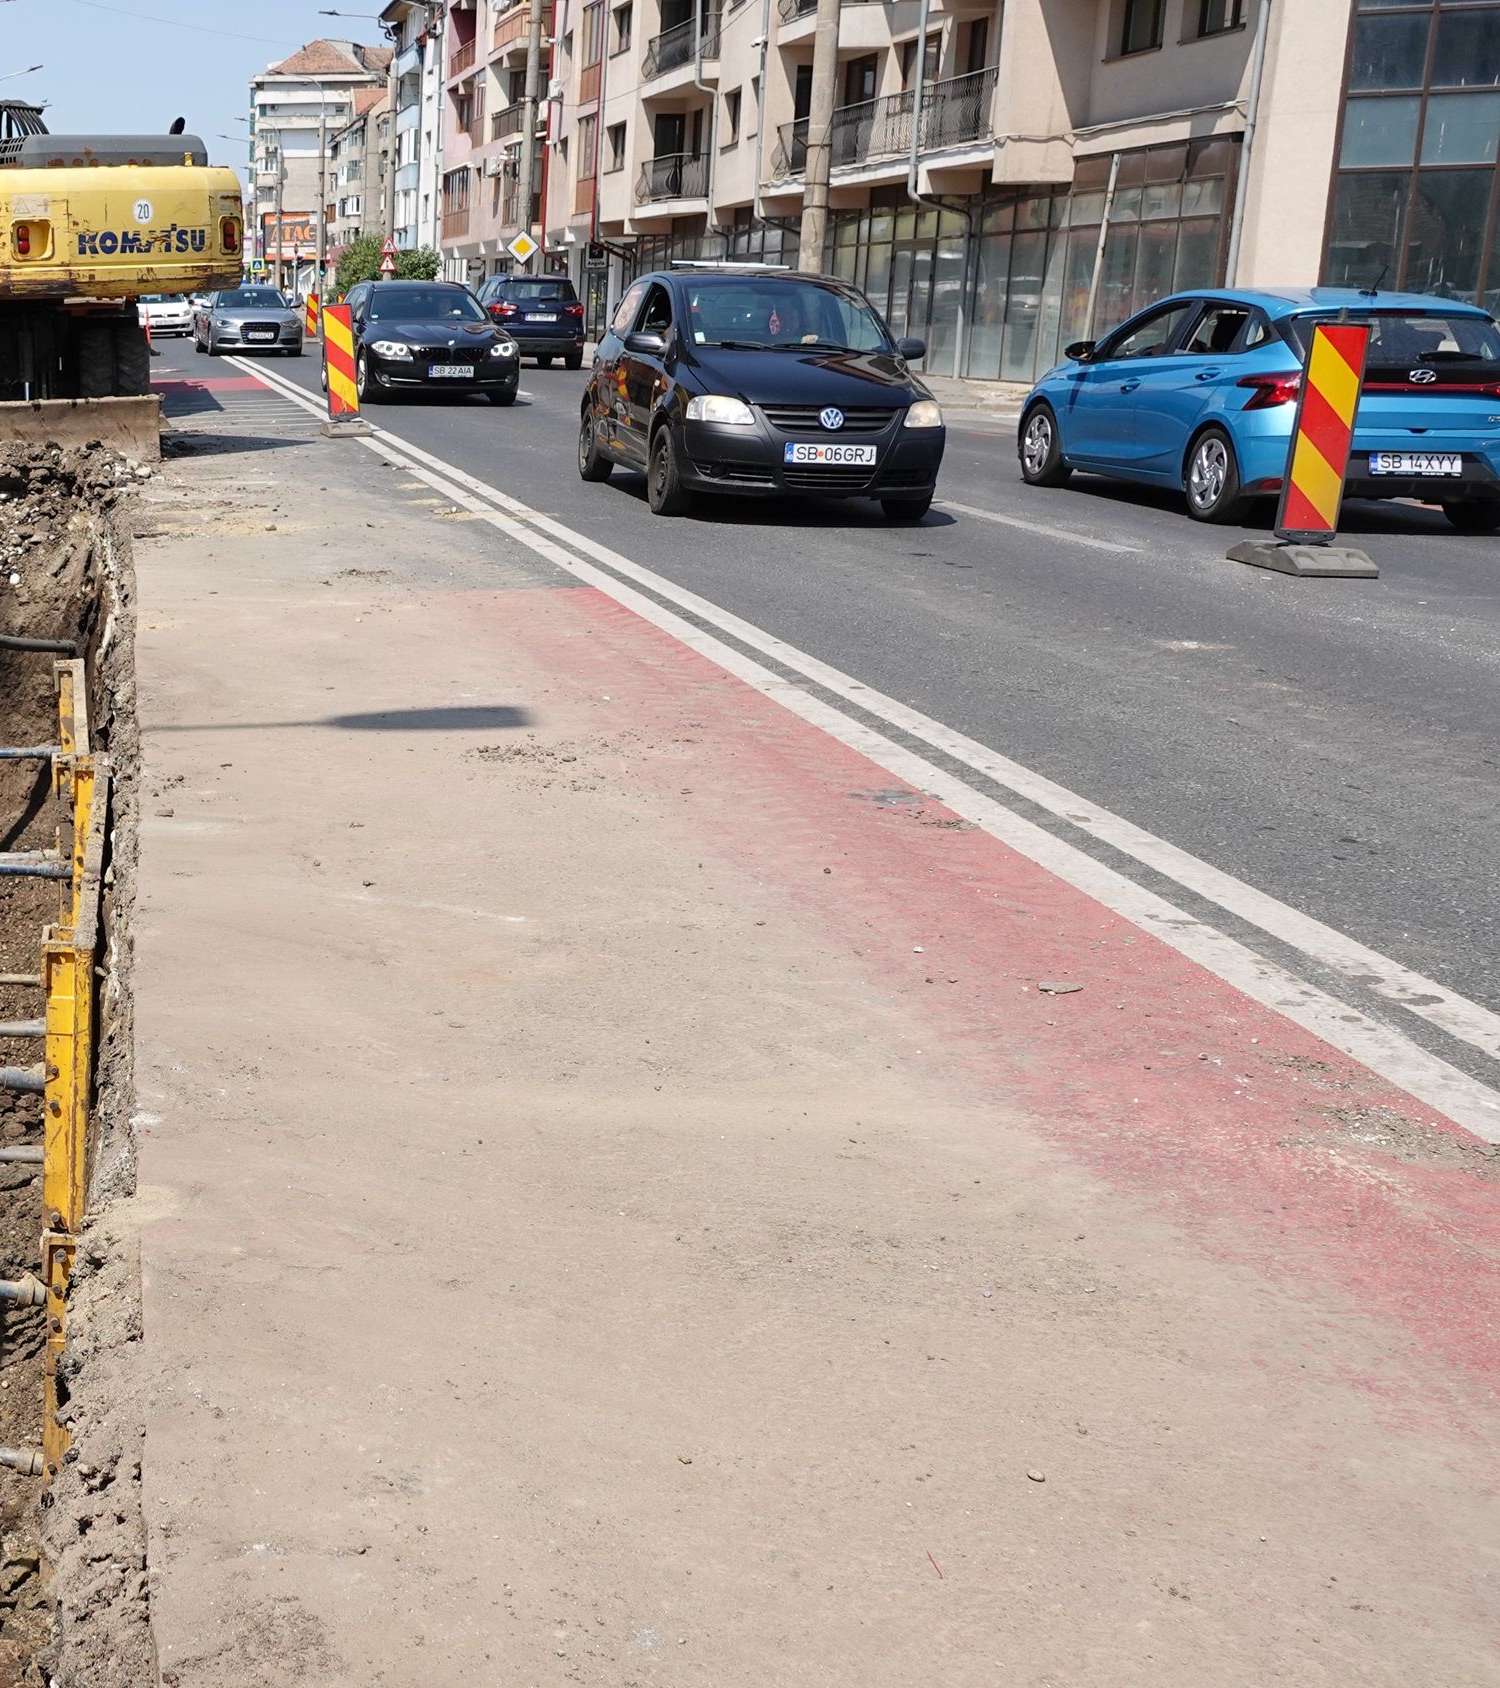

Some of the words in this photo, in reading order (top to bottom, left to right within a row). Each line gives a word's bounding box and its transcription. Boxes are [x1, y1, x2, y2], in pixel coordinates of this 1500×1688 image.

[137, 203, 149, 219] 20
[434, 366, 445, 375] SB
[796, 446, 818, 460] SB
[1380, 454, 1402, 469] SB
